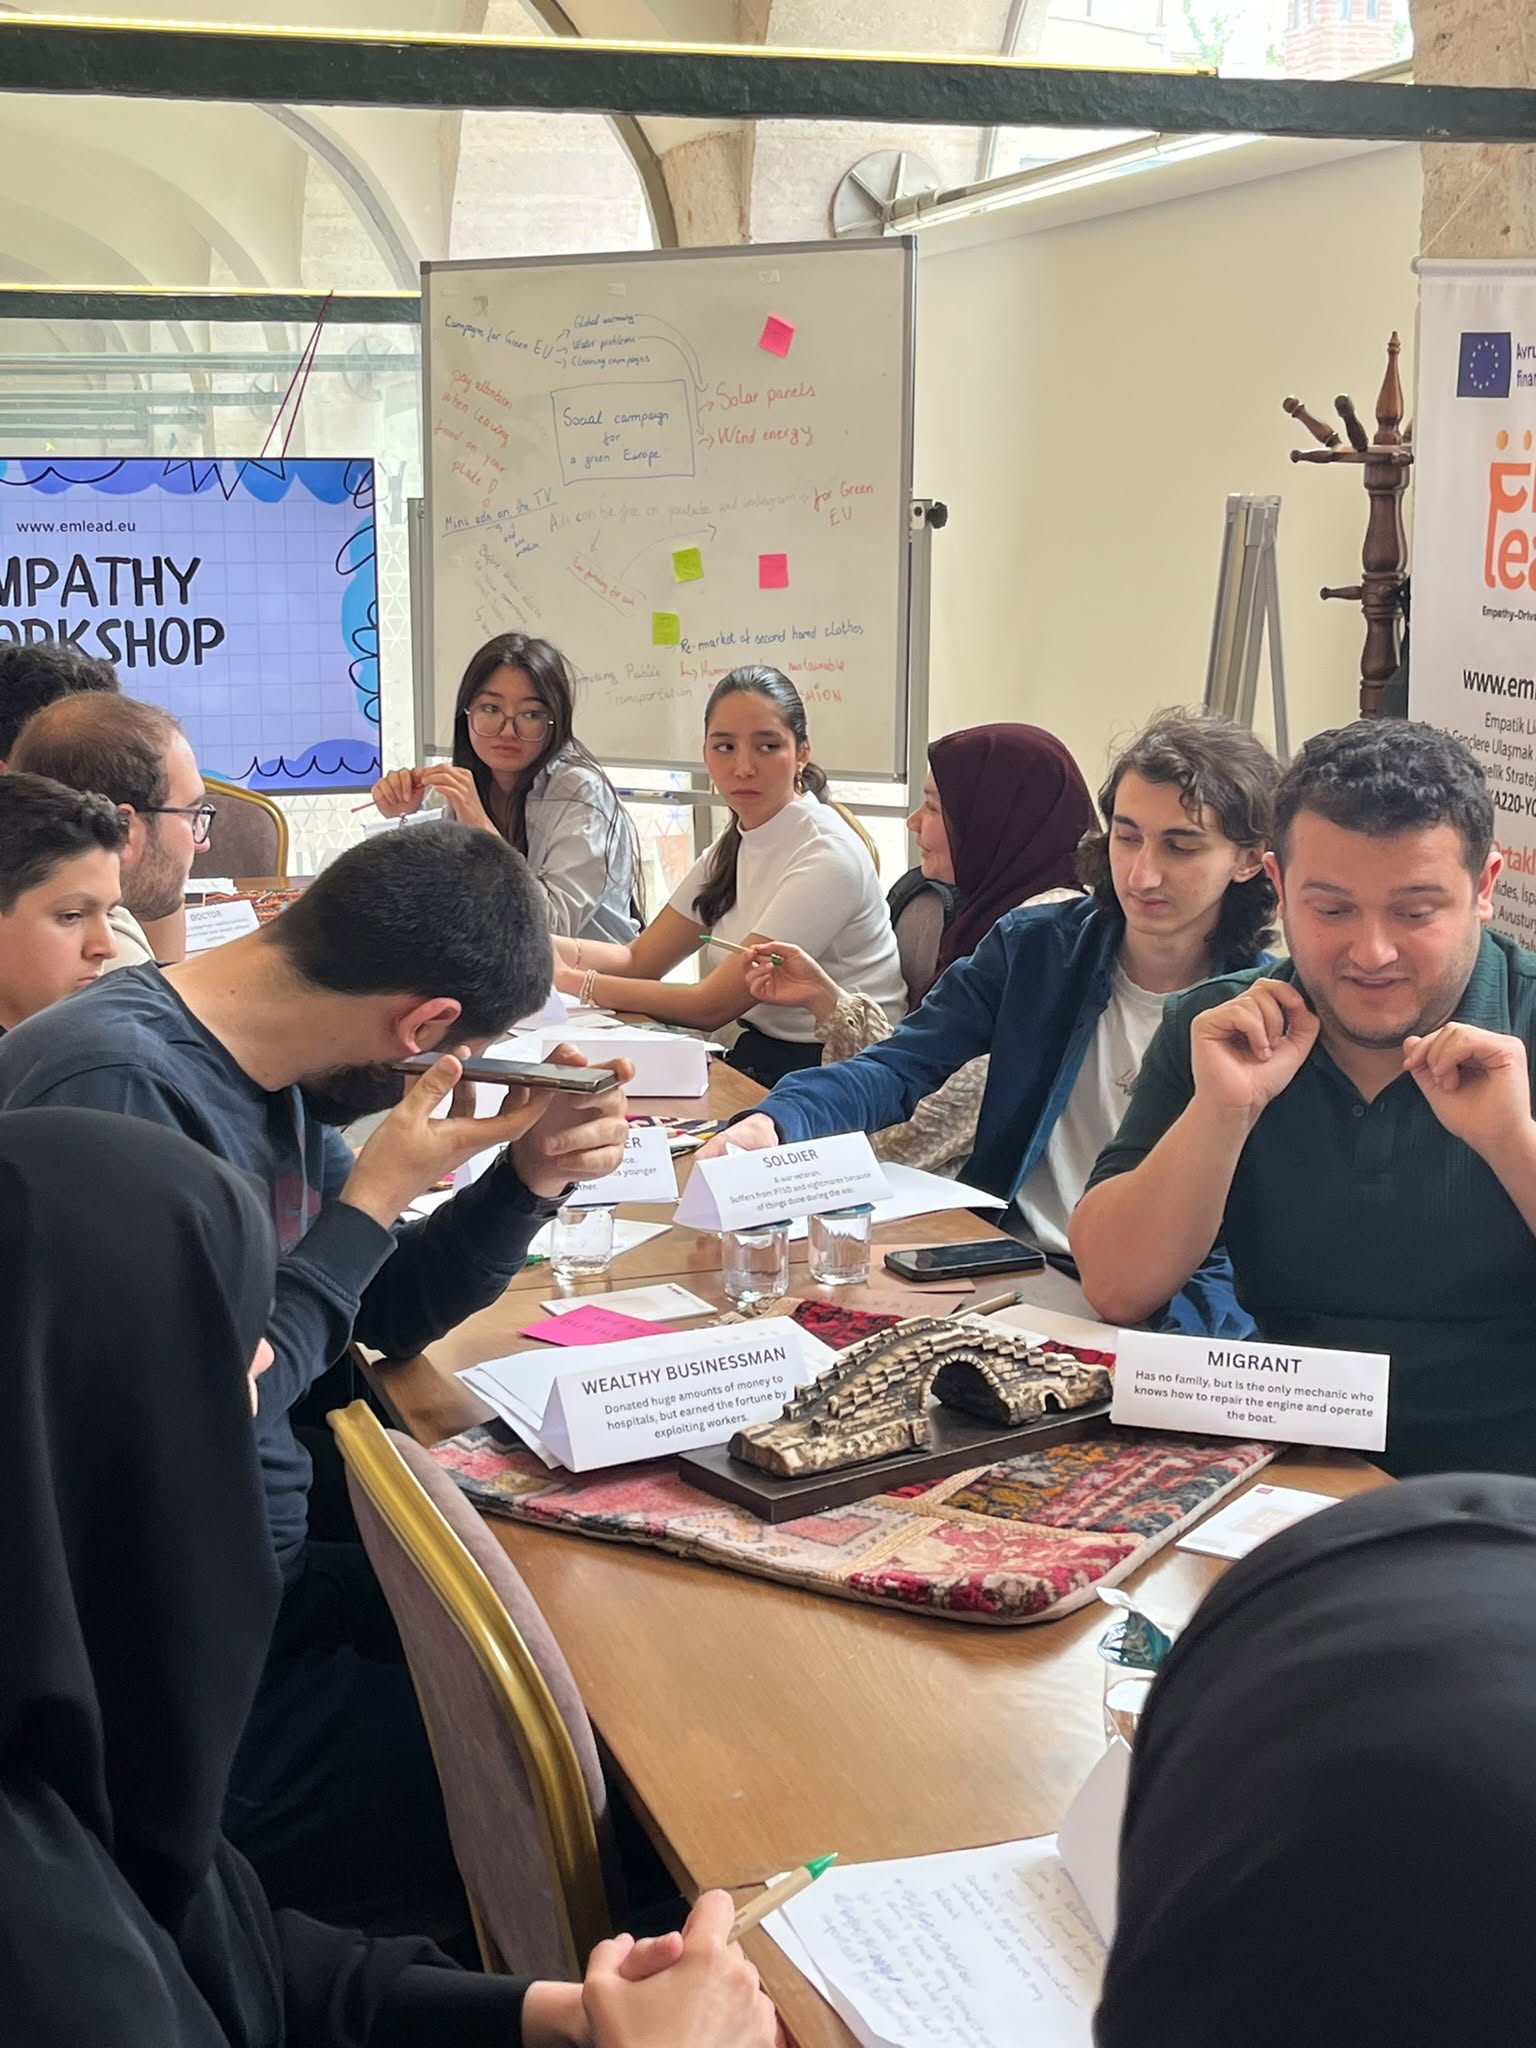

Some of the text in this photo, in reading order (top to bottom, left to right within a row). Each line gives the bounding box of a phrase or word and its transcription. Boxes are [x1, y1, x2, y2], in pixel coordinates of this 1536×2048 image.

[1516, 369, 1536, 388] fina
[715, 382, 817, 410] Solar panels
[562, 407, 602, 429] Social
[603, 431, 622, 448] for
[717, 425, 815, 449] Wind energy
[569, 455, 577, 465] a
[584, 453, 612, 470] green
[533, 487, 552, 506] TV
[813, 488, 832, 513] for
[839, 480, 875, 498] Green
[16, 519, 136, 533] www.emlead.eu
[829, 506, 853, 527] EU
[1485, 712, 1525, 735] Empatik
[1492, 739, 1534, 760] Ulaşmak
[624, 1136, 642, 1149] ER
[762, 1148, 820, 1168] SOLDIER
[581, 1346, 787, 1396] WEALTHY BUSINESSMAN
[1207, 1350, 1303, 1375] MIGRANT
[604, 1373, 784, 1416] Donated huge amounts of money to
[1135, 1369, 1374, 1403] Has no family, but is the only mechanic who
[606, 1389, 788, 1431] hospitals, but earned the fortune by
[1134, 1386, 1374, 1418] knows how to repair the engine and operate
[654, 1412, 750, 1439] exploiting workers.
[1226, 1409, 1277, 1424] the boat.
